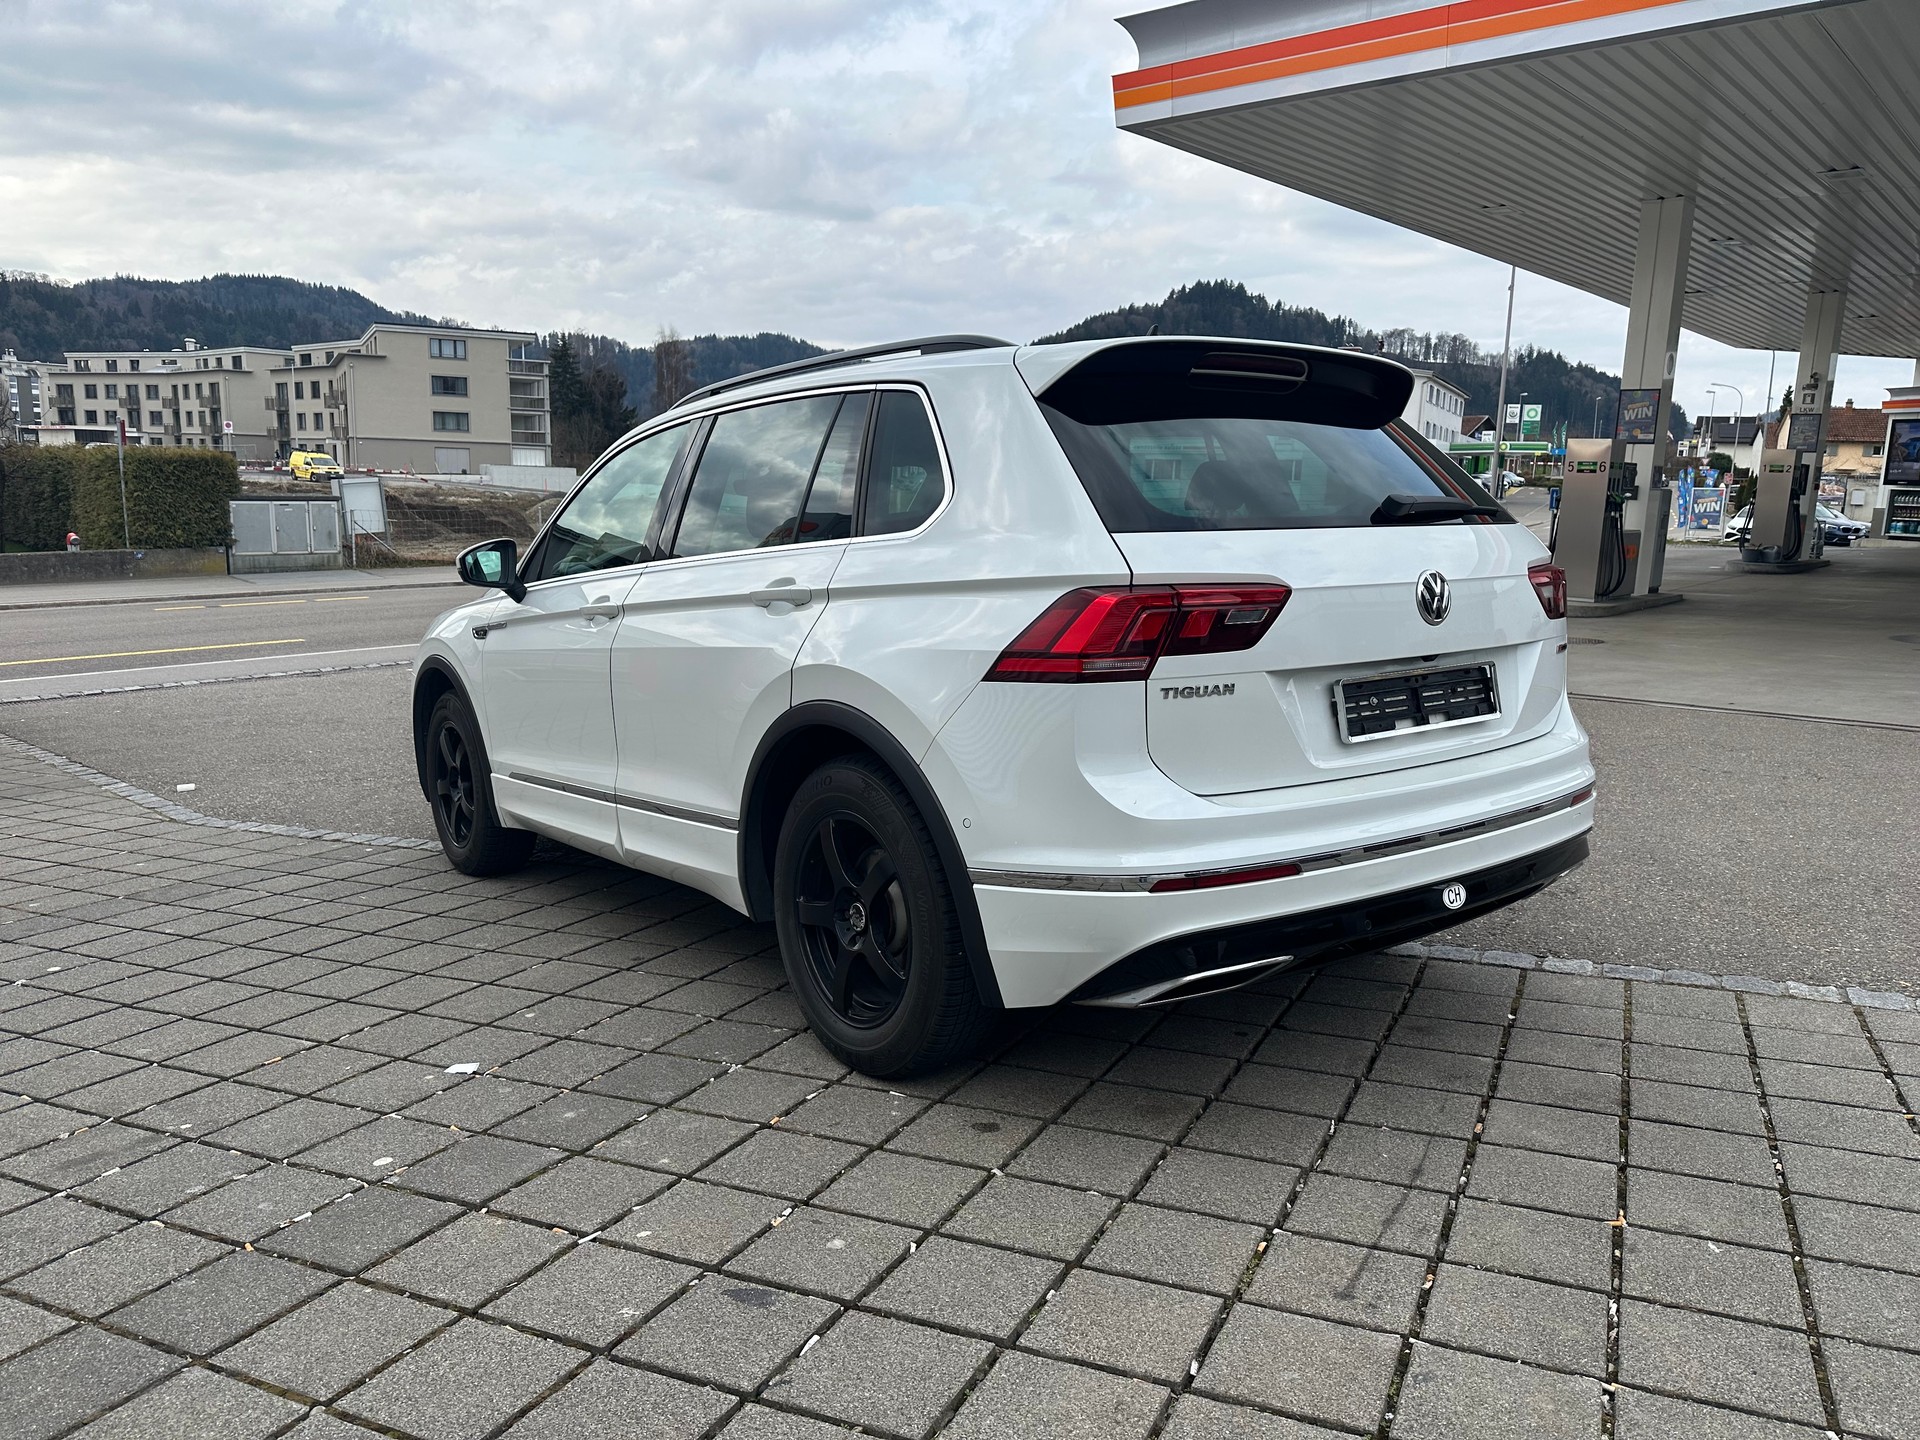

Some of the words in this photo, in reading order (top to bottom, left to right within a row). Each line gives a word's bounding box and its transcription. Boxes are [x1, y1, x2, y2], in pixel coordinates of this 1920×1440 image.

[1623, 405, 1653, 421] WIN
[1567, 461, 1575, 473] 5
[1599, 461, 1607, 473] 6
[1785, 464, 1792, 473] 2
[1693, 501, 1721, 514] WIN
[1160, 683, 1236, 700] TIGUAN
[1447, 887, 1462, 904] CH
